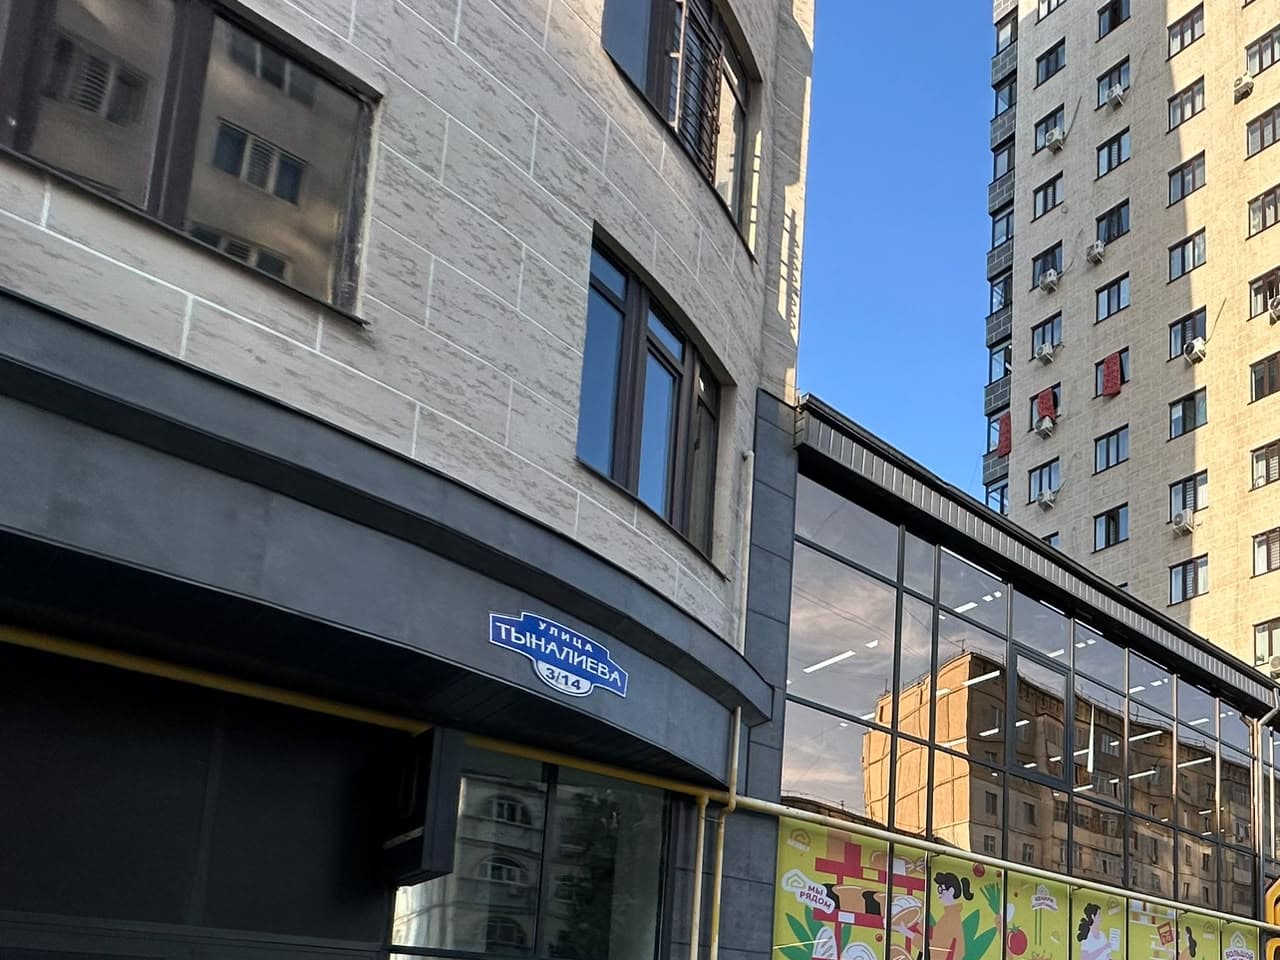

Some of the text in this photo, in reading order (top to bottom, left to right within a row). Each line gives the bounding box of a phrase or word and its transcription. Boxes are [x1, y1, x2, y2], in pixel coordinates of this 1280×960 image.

[538, 621, 593, 652] УЛИЦА
[495, 622, 621, 687] ТЫНАЛИЕВА
[546, 667, 580, 690] 3/14
[800, 891, 831, 910] РЯДОМ
[808, 885, 824, 896] МЫ
